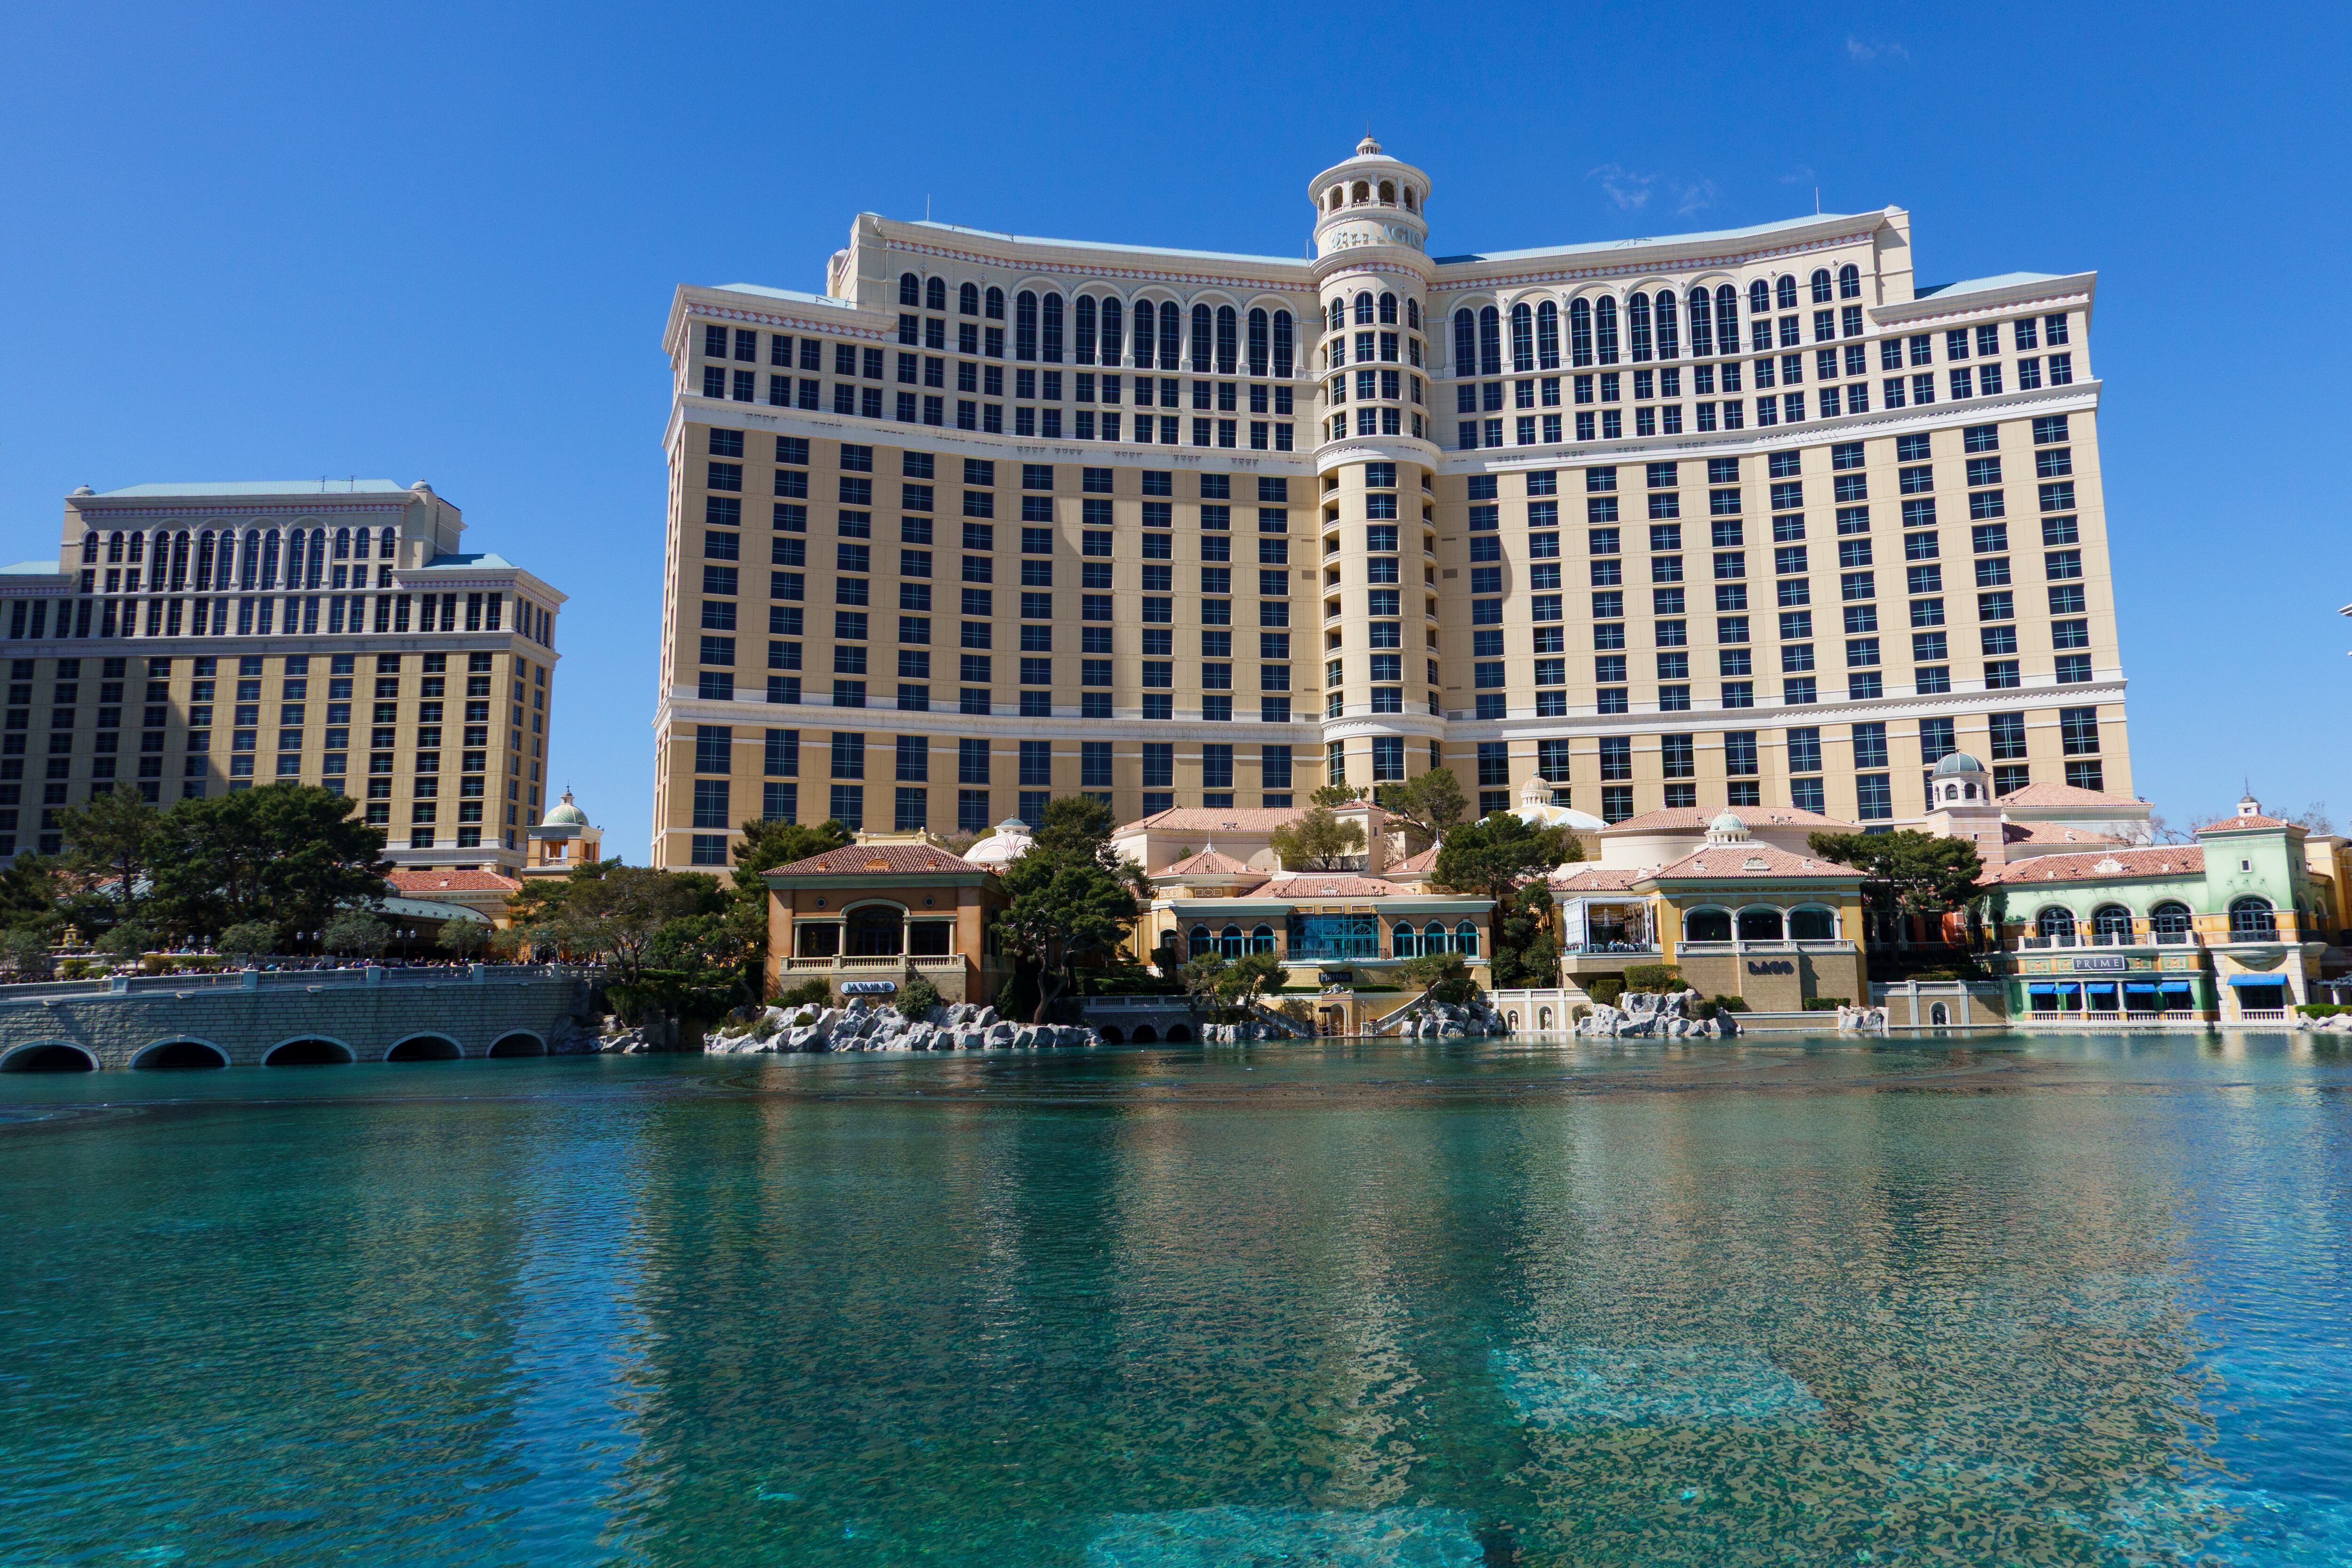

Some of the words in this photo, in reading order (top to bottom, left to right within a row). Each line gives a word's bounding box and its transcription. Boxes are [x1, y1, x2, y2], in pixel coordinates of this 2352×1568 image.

[1327, 223, 1422, 251] BELLAGIO
[2076, 958, 2119, 969] PRIME
[1321, 973, 1350, 982] MAYFAIR
[845, 982, 891, 992] JASMINE
